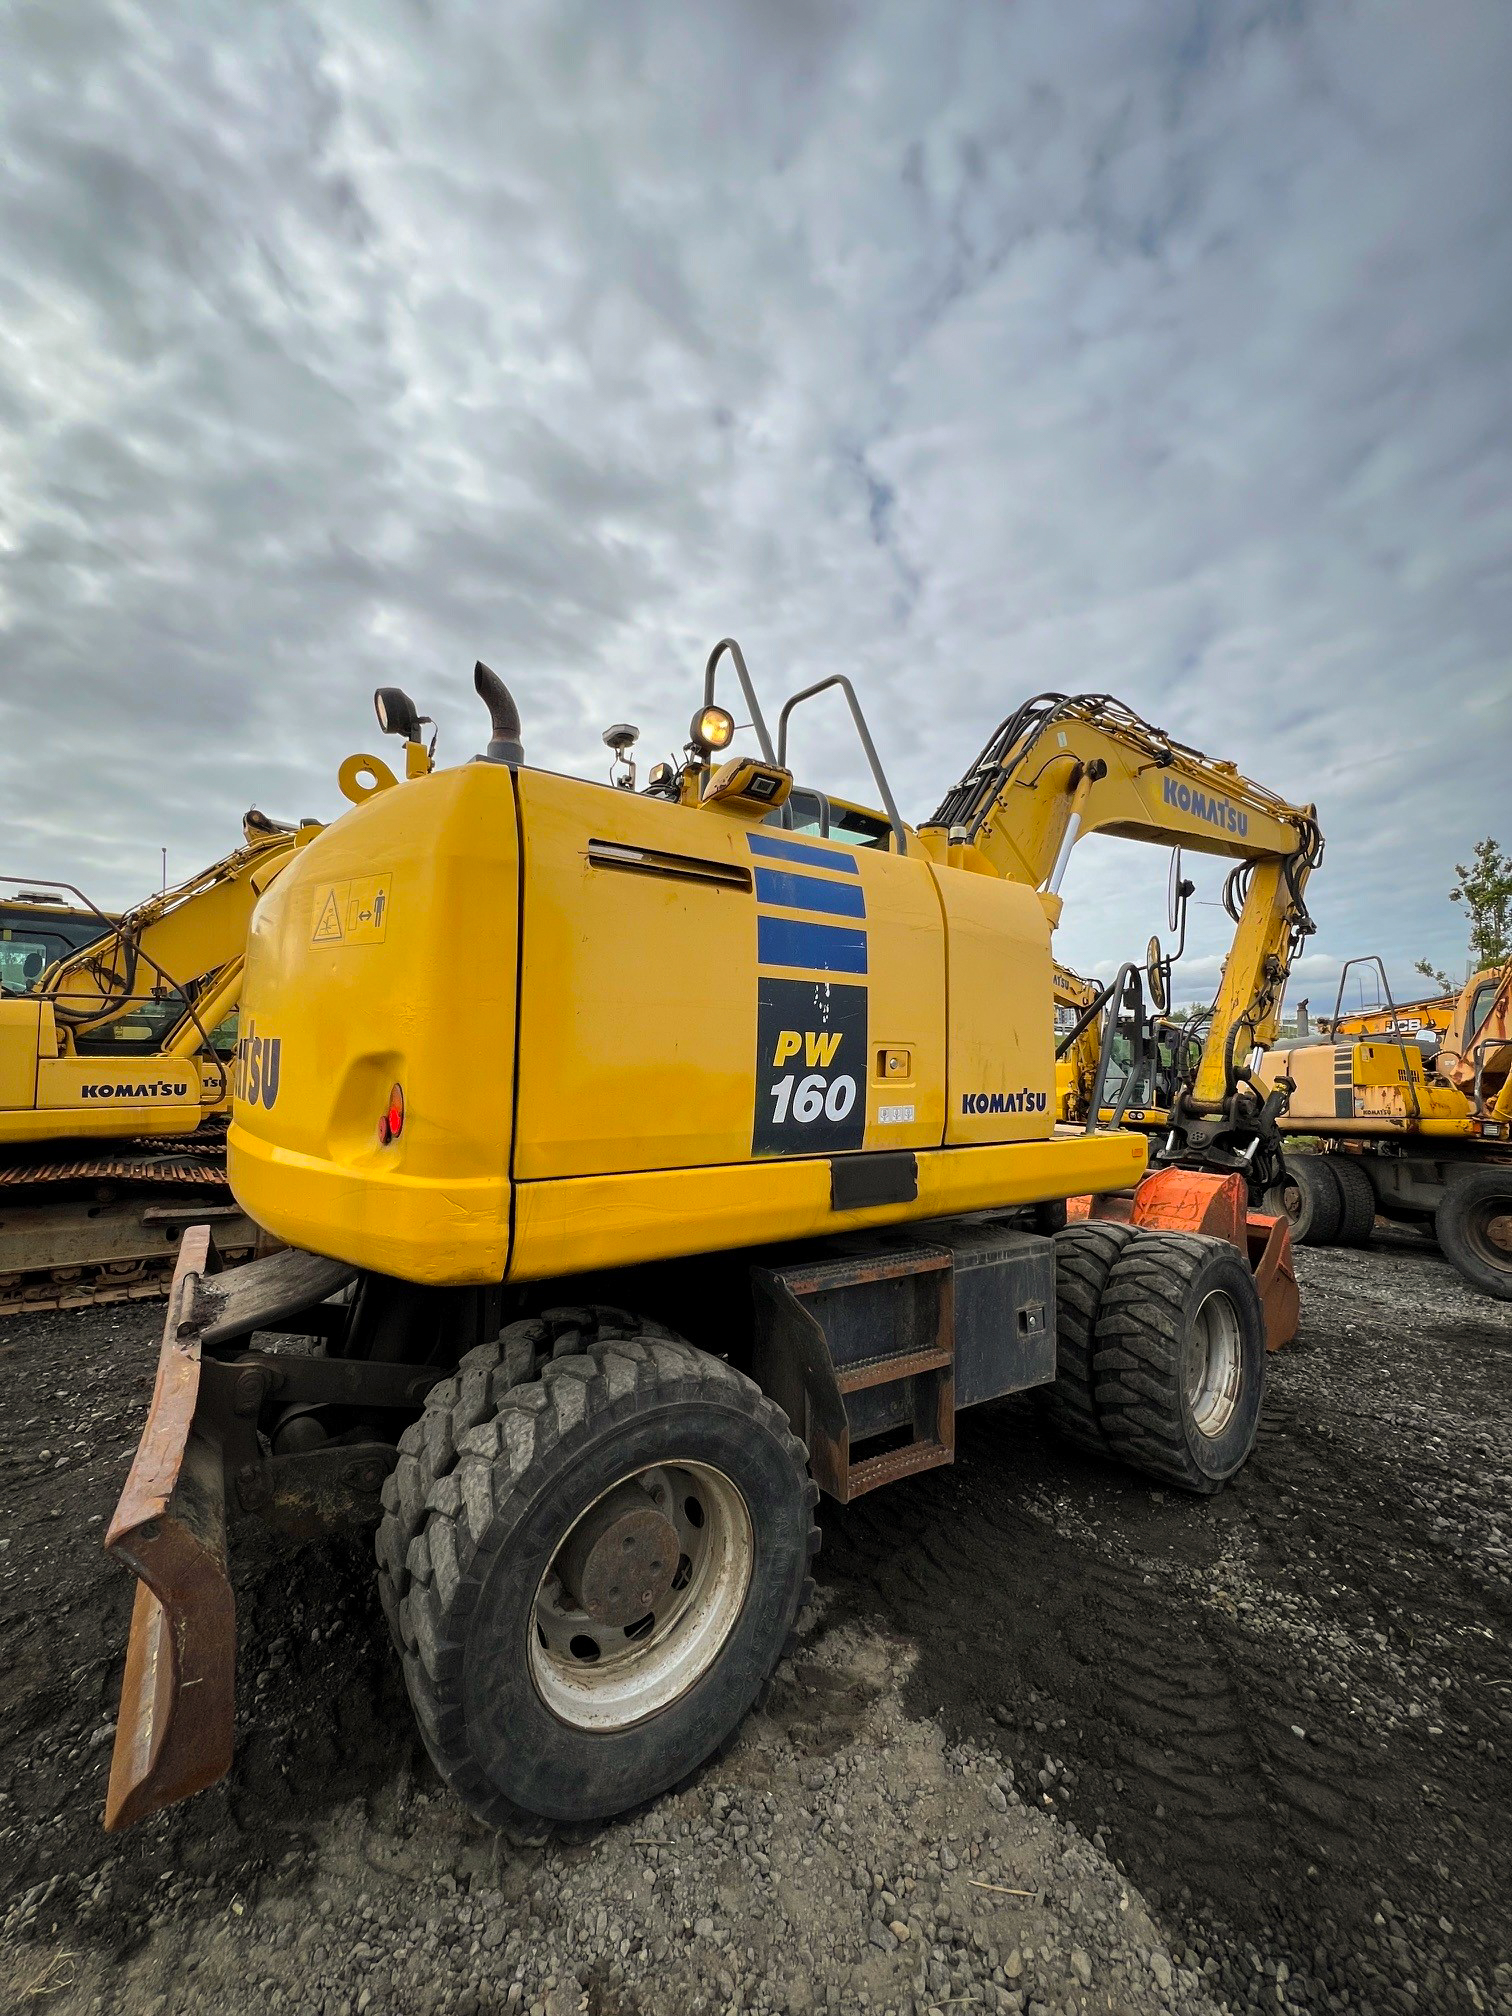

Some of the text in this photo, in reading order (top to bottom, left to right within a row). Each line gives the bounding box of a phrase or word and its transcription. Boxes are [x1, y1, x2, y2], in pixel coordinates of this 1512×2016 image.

[1164, 776, 1248, 837] KOMATSU
[1385, 1020, 1421, 1032] JCB
[772, 1031, 843, 1067] PW
[82, 1081, 187, 1098] KOMATSU
[770, 1074, 856, 1124] 160
[962, 1088, 1046, 1114] KOMATSU
